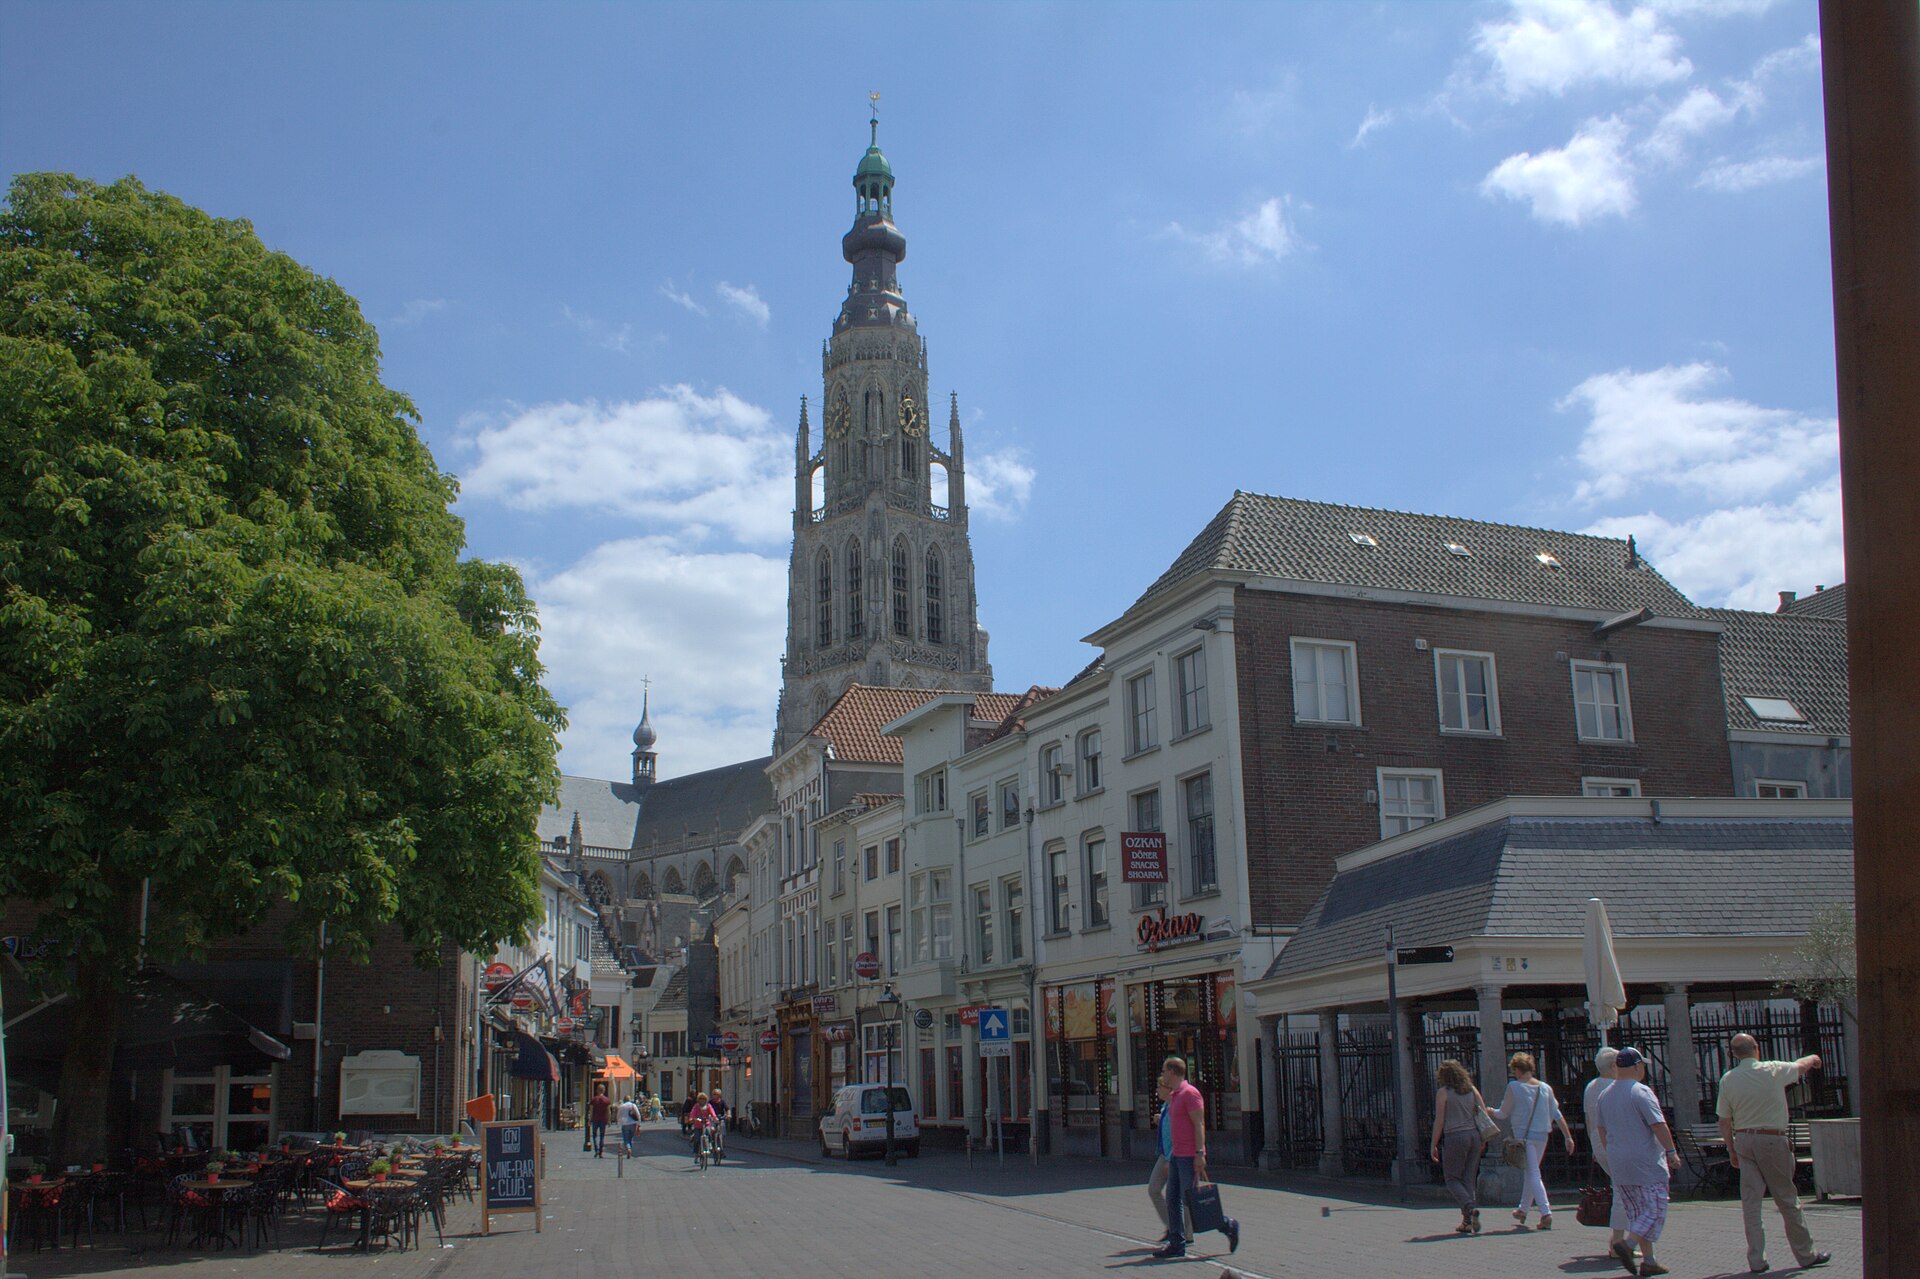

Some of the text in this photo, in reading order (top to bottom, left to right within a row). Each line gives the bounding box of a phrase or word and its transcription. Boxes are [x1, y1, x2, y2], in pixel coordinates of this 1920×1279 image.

[1125, 836, 1162, 849] OZKAN
[1131, 850, 1158, 859] DÖNER
[1130, 861, 1159, 869] SNACKS
[1127, 871, 1163, 879] SHOARMA
[497, 1178, 525, 1197] CLUB
